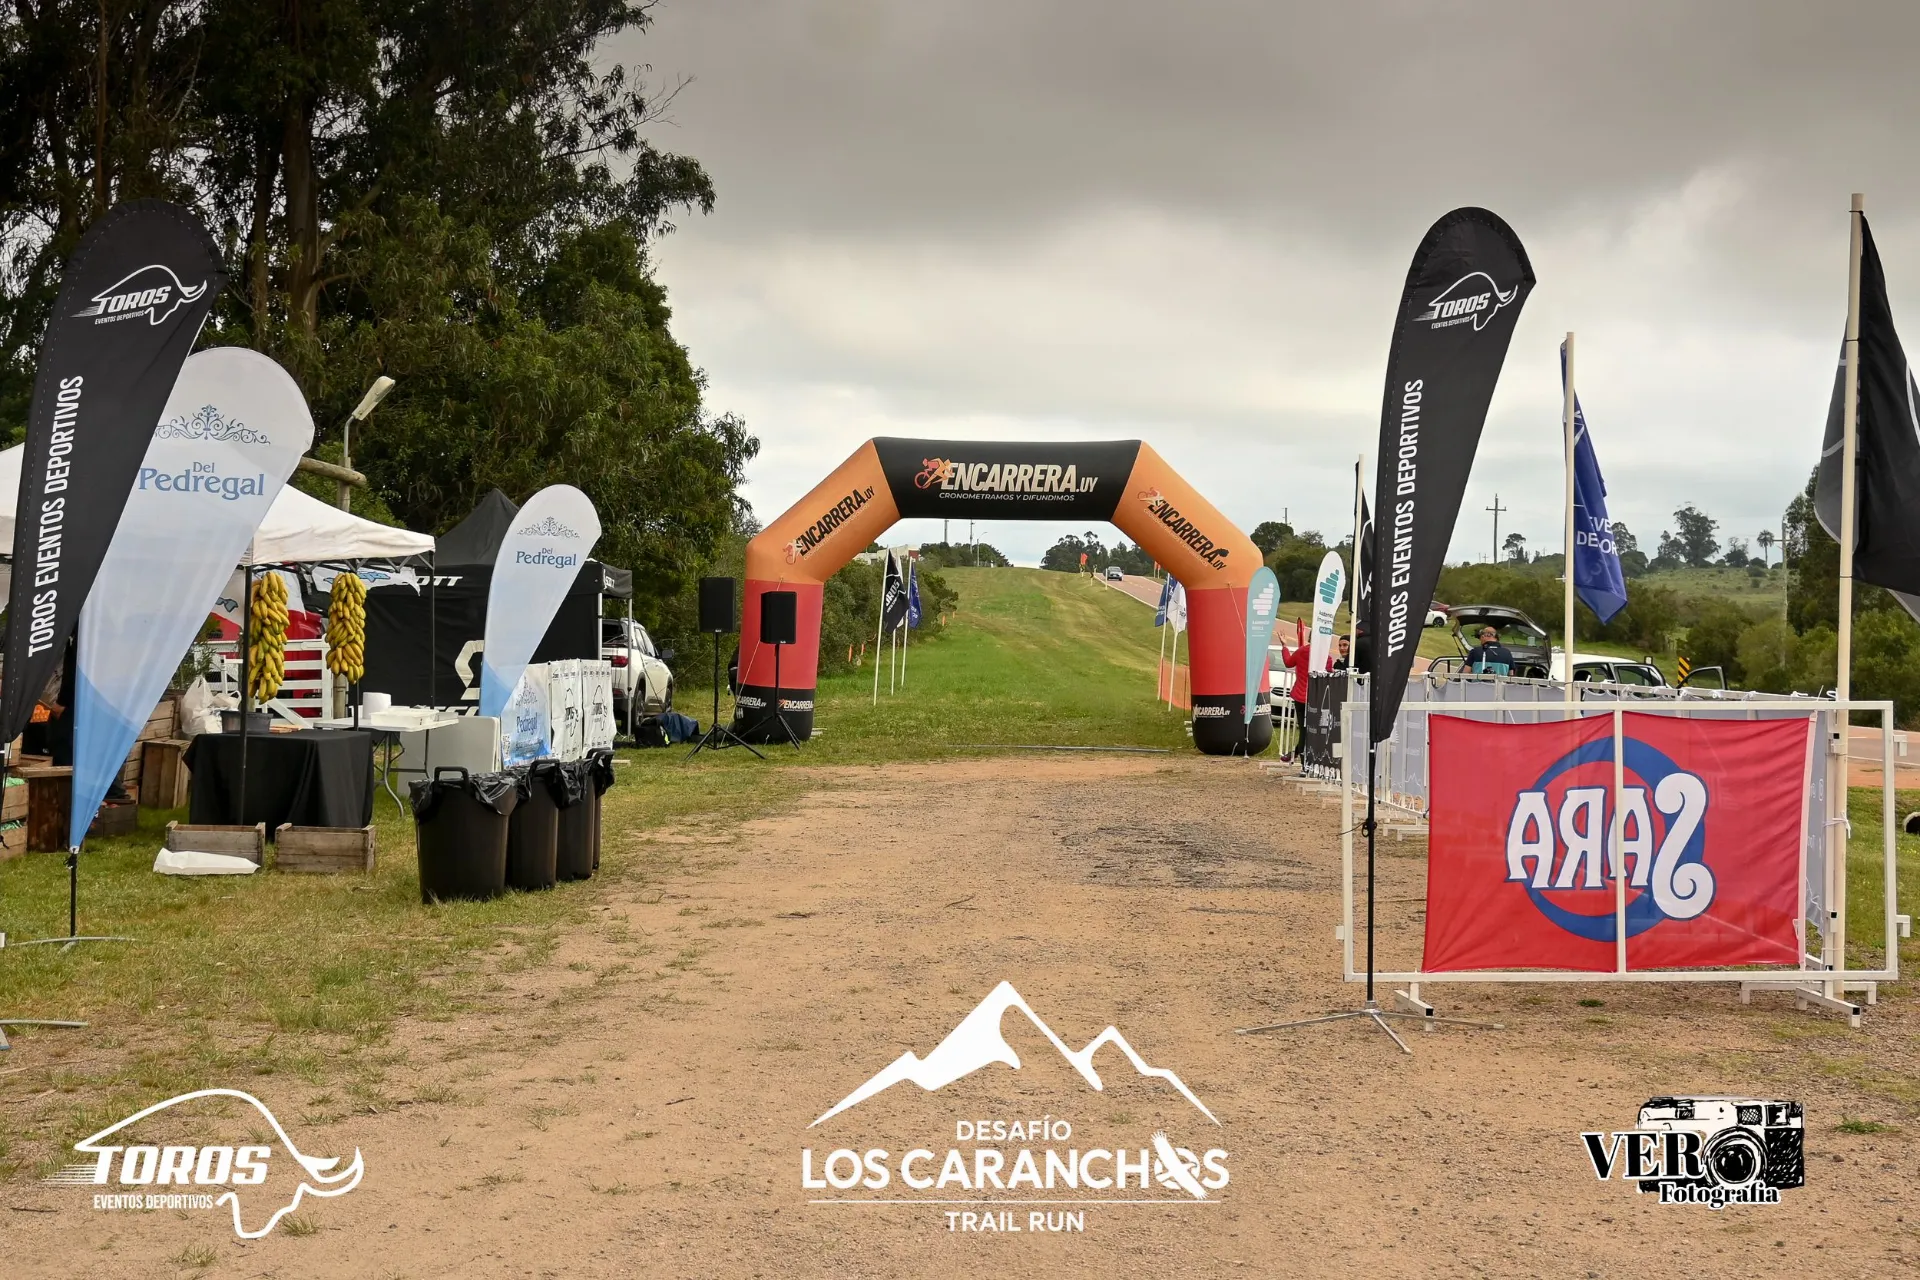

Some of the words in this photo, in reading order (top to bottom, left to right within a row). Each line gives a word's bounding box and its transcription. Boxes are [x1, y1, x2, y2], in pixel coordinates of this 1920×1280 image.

[97, 286, 171, 315] TOROS
[1432, 292, 1491, 319] TOROS
[94, 316, 116, 325] EVENTOS
[116, 310, 146, 322] DEPORTIVOS
[44, 375, 84, 494] DEPORTIVOS
[1396, 379, 1424, 496] DEPORTIVOS
[192, 461, 215, 473] Del
[940, 463, 1099, 493] ENCARRERA.UY
[138, 467, 265, 500] Pedregal
[938, 492, 1014, 501] CRONOMETRAMOS
[1022, 494, 1075, 502] DIFUNDIMOS
[35, 497, 65, 588] EVENTOS
[541, 547, 553, 555] Del
[1391, 500, 1415, 588] EVENTOS
[515, 551, 577, 569] Pedregal
[28, 589, 58, 658] TOROS
[1387, 590, 1409, 658] TOROS
